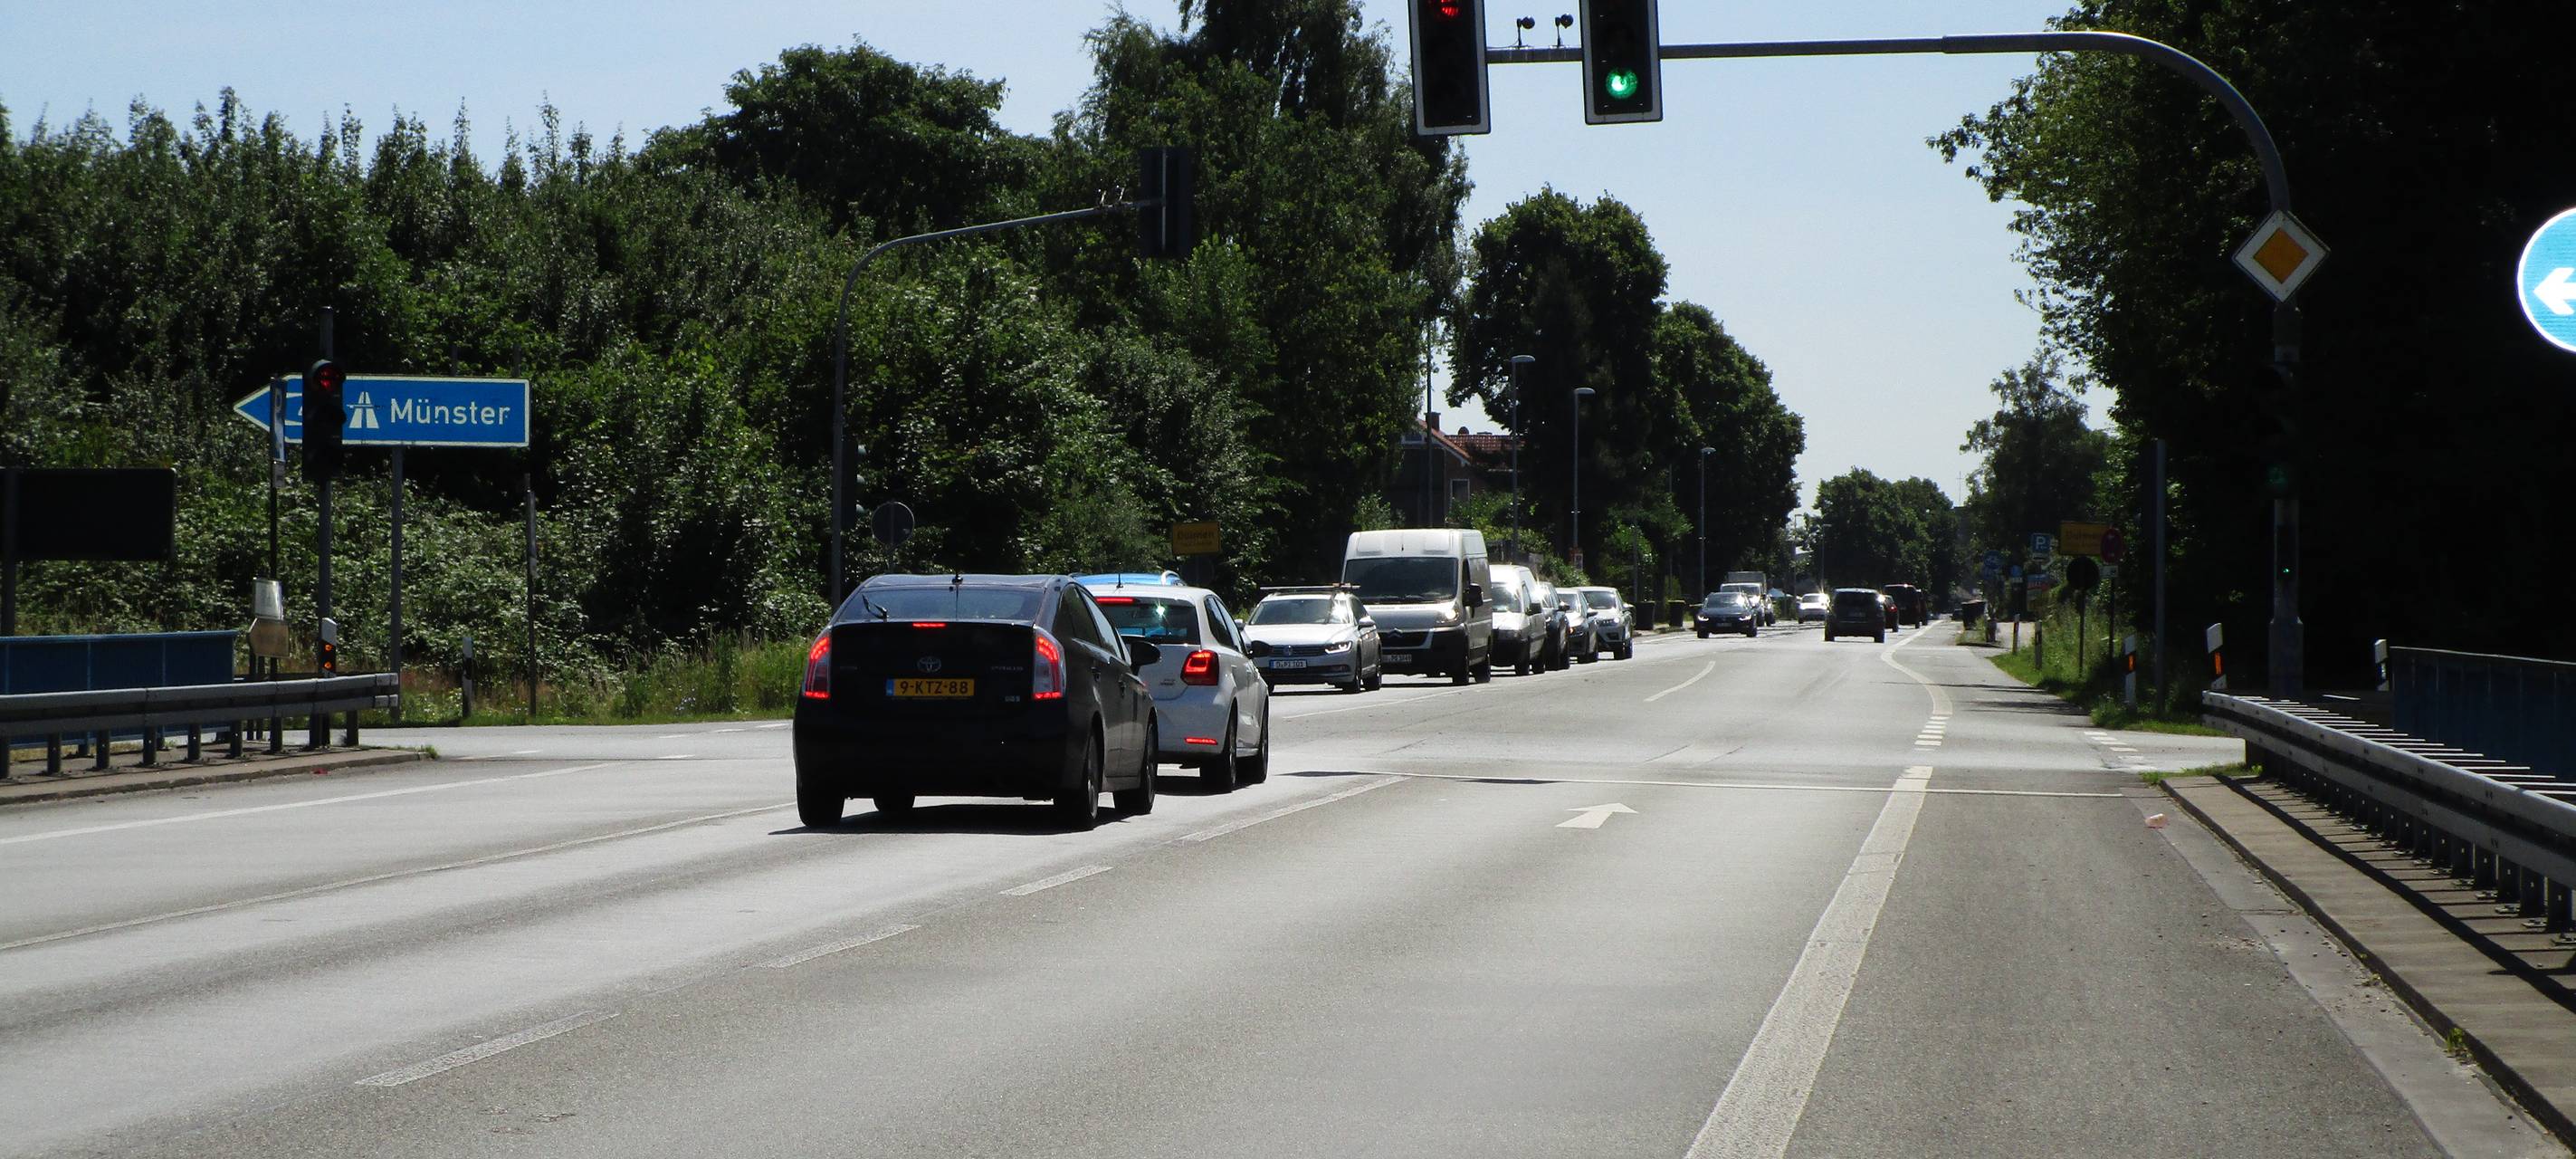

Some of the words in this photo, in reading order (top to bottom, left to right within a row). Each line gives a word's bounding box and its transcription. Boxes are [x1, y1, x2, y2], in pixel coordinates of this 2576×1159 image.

[391, 398, 510, 426] Münster
[2036, 536, 2046, 550] P
[900, 681, 968, 695] 9-KTZ-88
